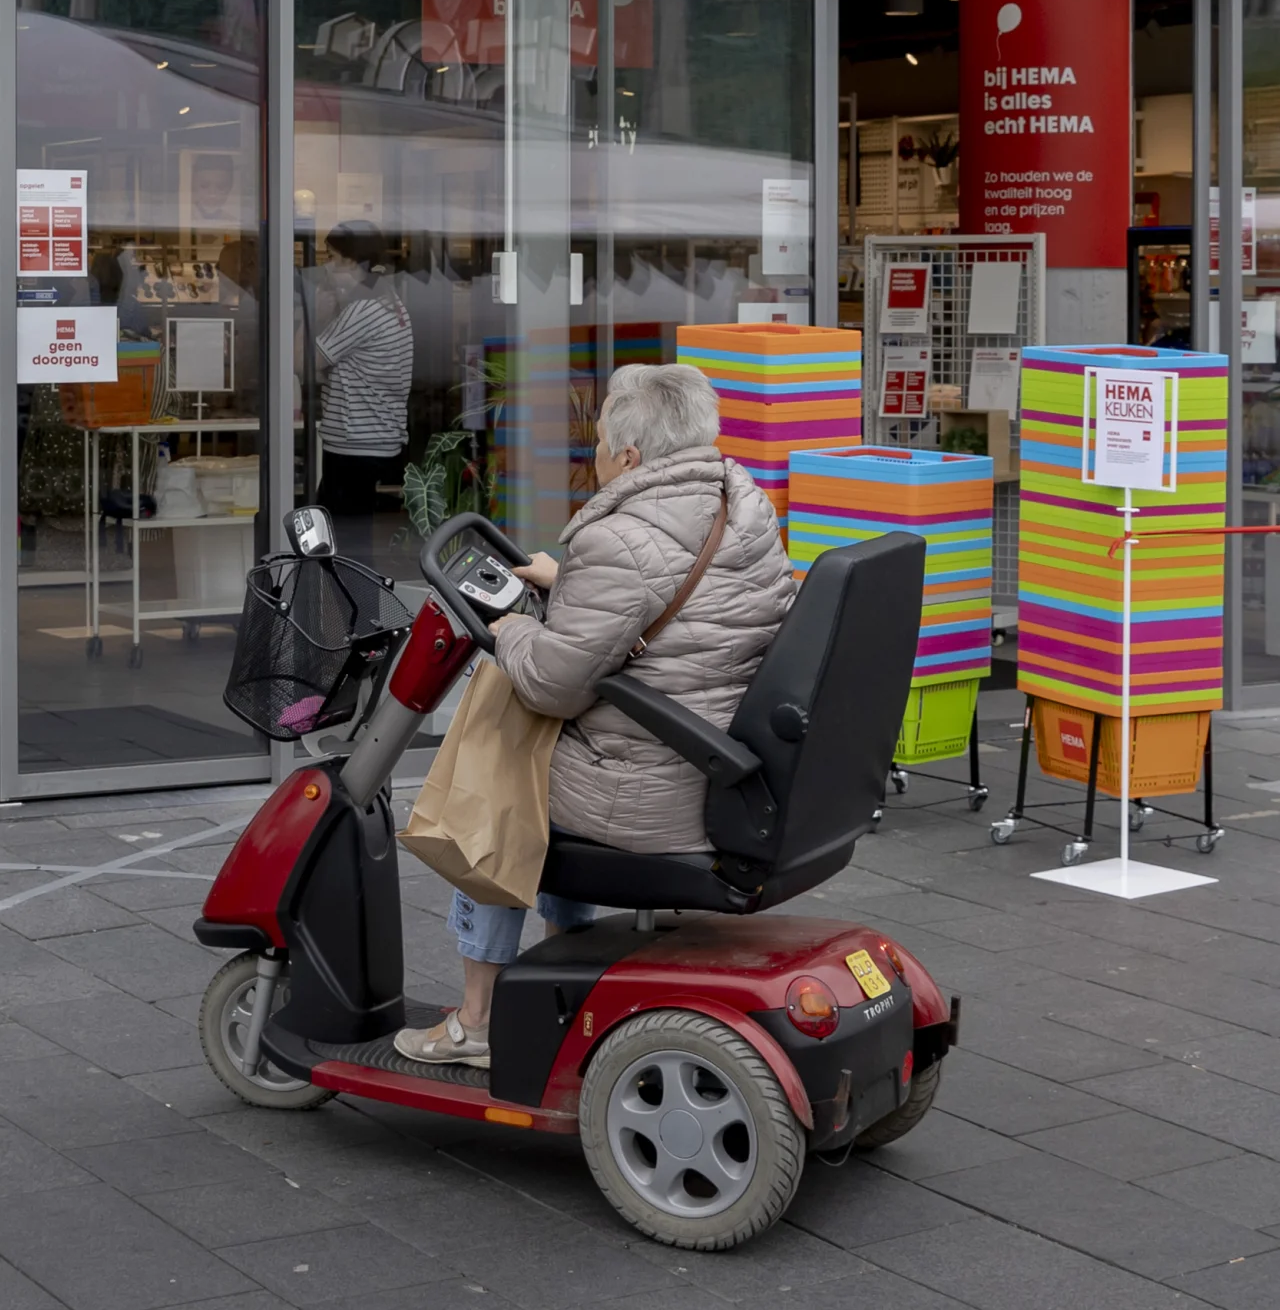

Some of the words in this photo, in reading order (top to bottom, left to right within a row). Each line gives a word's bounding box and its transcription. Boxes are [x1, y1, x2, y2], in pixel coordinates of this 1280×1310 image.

[984, 66, 1007, 90] bij
[1011, 66, 1077, 85] HEMA
[984, 92, 997, 111] is
[1001, 92, 1052, 110] alles
[984, 117, 1026, 135] echt
[1030, 115, 1094, 134] HEMA
[985, 172, 998, 183] Zo
[1000, 171, 1050, 182] houden
[1052, 172, 1073, 182] we
[1076, 170, 1093, 181] de
[985, 187, 1032, 199] kwaliteit
[1035, 187, 1072, 201] hoog
[985, 206, 998, 216] en
[1000, 205, 1016, 216] de
[1019, 204, 1065, 218] prijzen
[49, 342, 82, 354] geen
[32, 354, 99, 367] doorgang
[1105, 384, 1153, 402] HEMA
[1105, 401, 1153, 419] KEUKEN
[1060, 733, 1086, 749] HEMA
[863, 974, 886, 993] 131
[863, 995, 895, 1020] TROPHY
